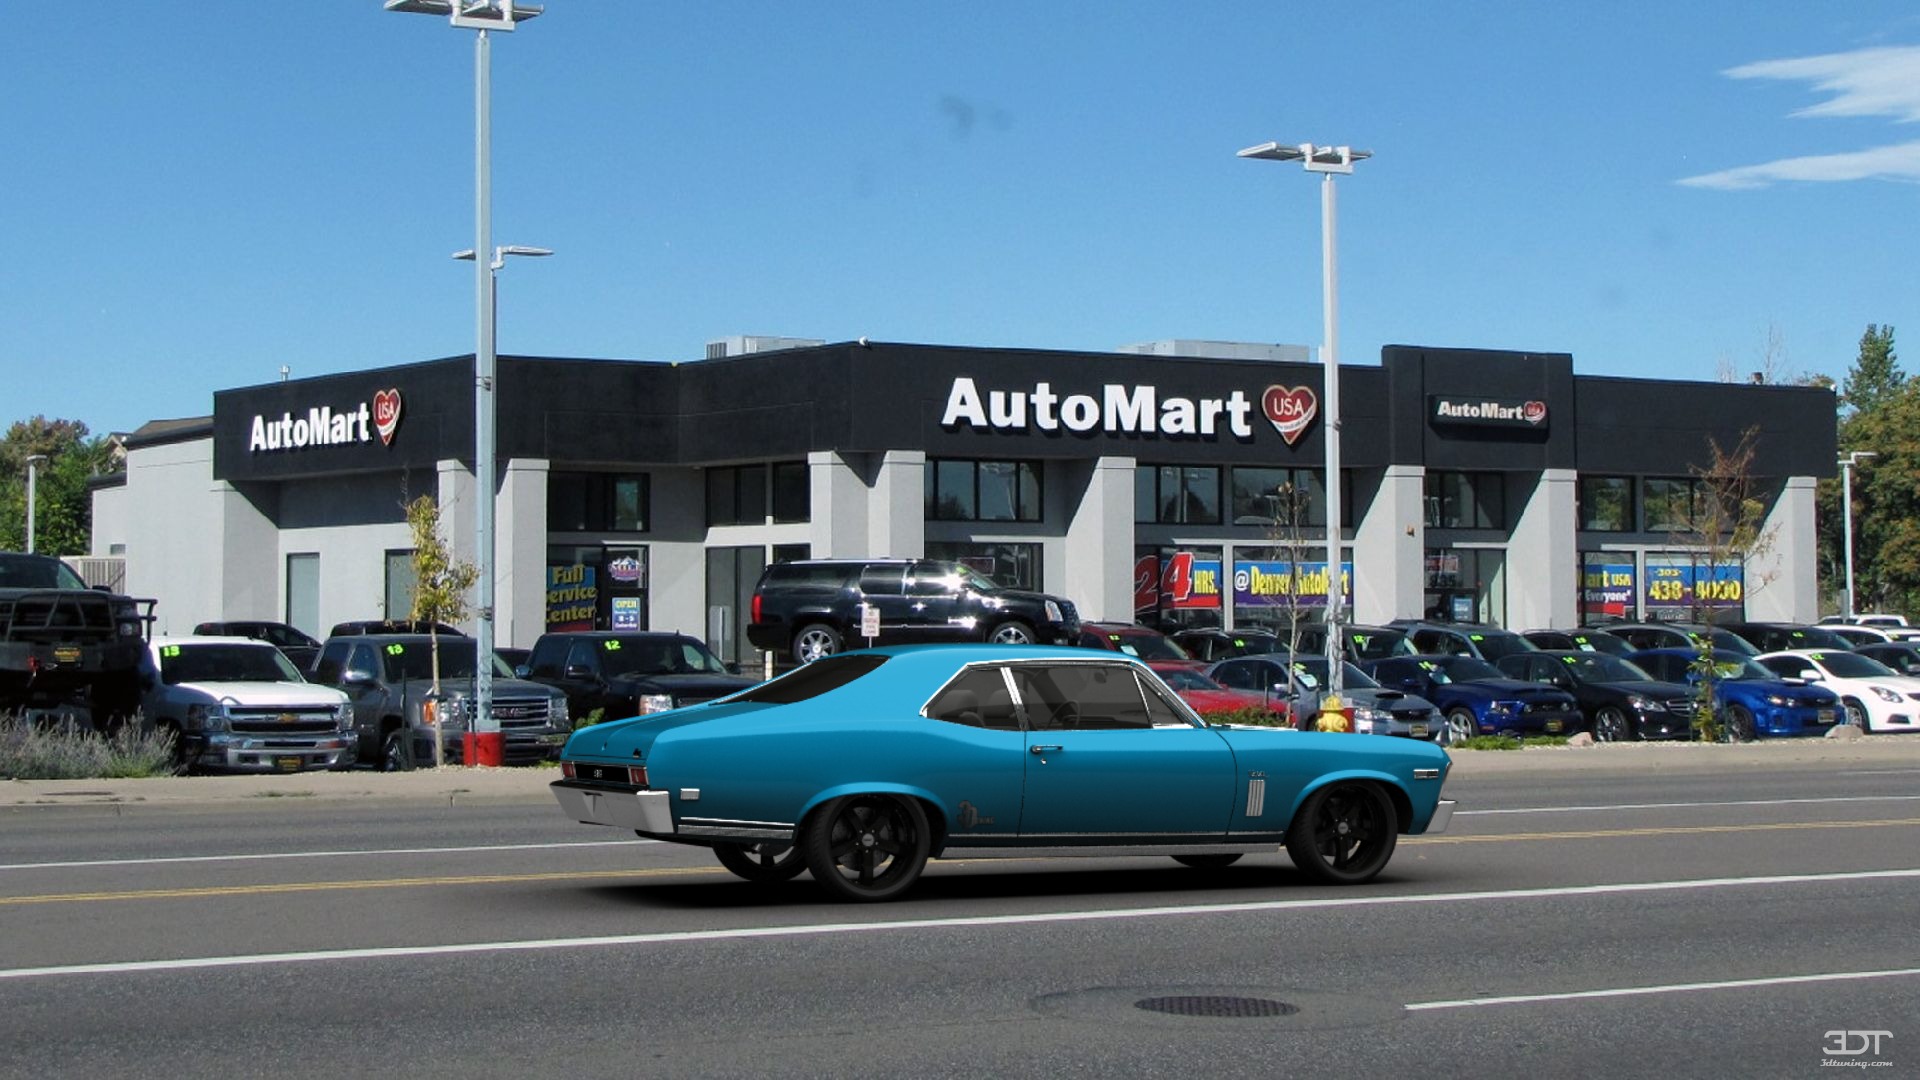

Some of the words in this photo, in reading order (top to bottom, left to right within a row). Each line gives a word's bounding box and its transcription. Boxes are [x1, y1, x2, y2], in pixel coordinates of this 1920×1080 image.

[378, 400, 395, 420] USA
[942, 377, 1252, 437] AutoMart
[1274, 397, 1305, 416] USA
[1438, 401, 1524, 420] AutoMart
[250, 402, 370, 452] AutoMart
[552, 564, 585, 585] Full
